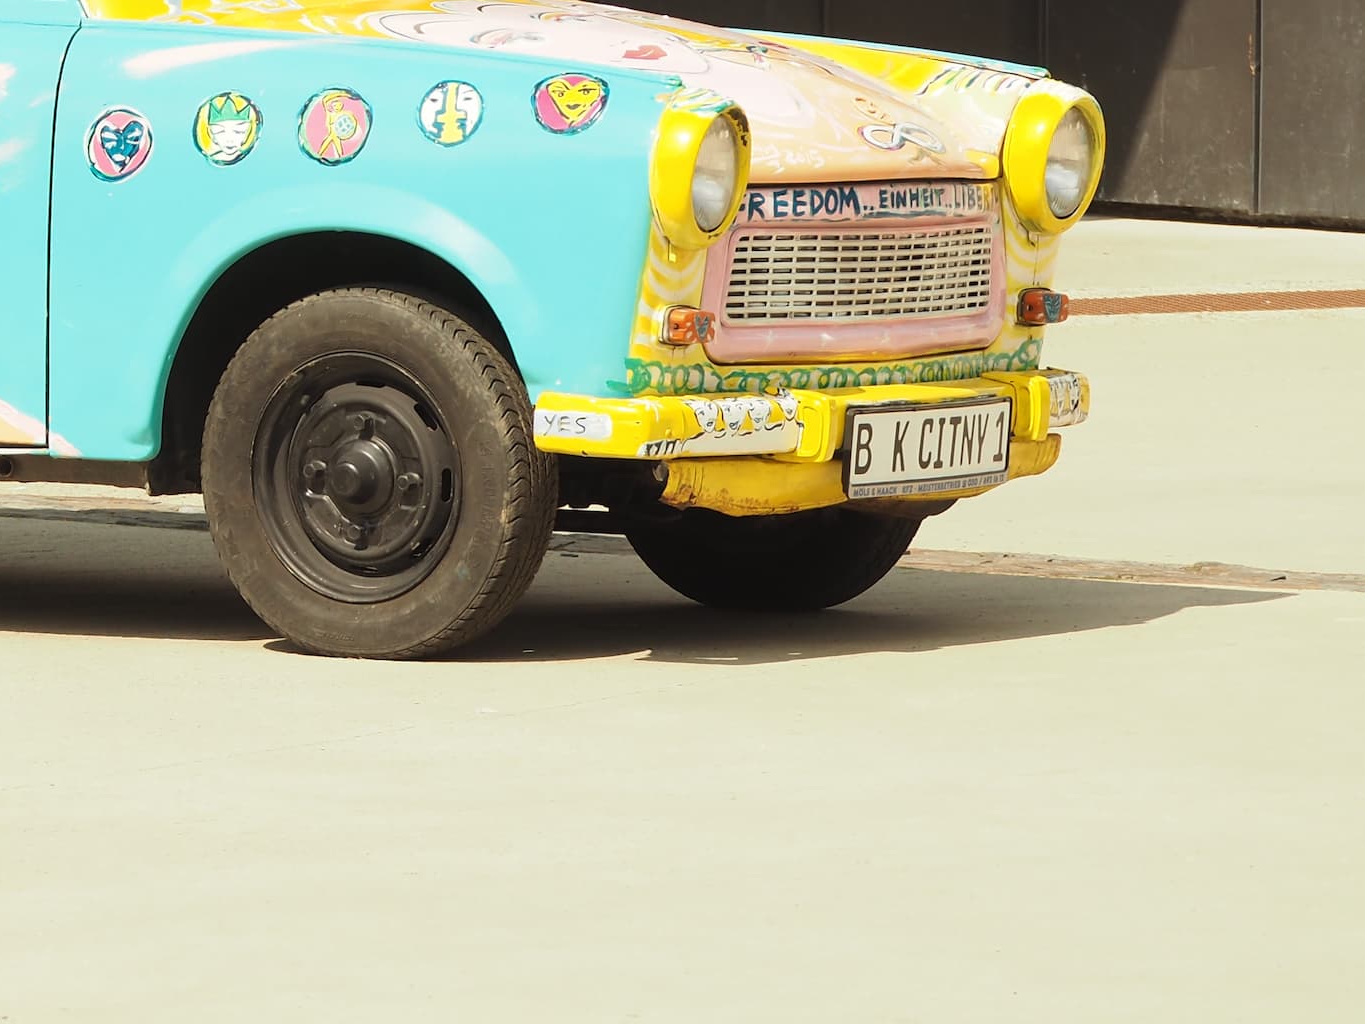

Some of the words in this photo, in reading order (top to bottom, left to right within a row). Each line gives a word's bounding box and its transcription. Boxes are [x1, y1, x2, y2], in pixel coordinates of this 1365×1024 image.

[543, 414, 588, 437] YES
[854, 423, 874, 475] B
[891, 420, 910, 472] K
[918, 413, 990, 470] CITNY
[992, 411, 1005, 462] 1
